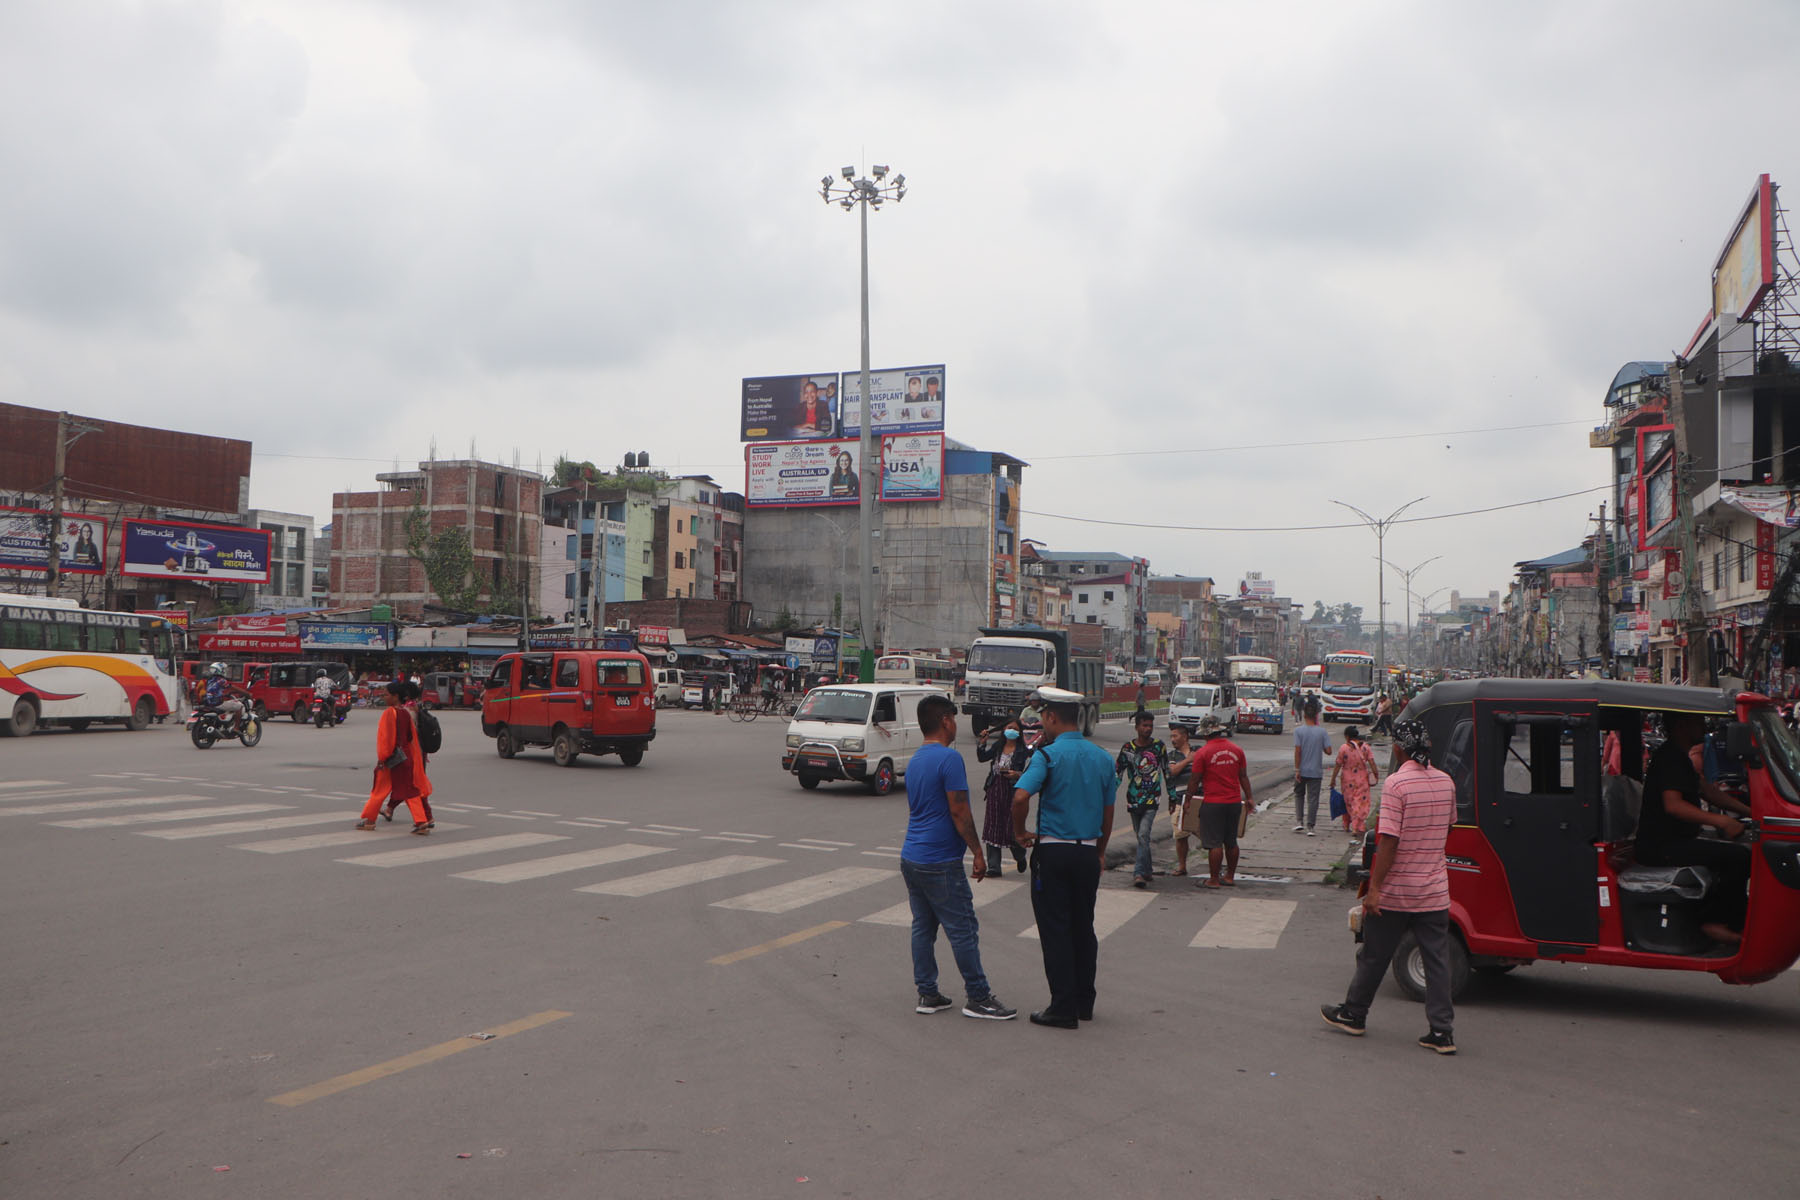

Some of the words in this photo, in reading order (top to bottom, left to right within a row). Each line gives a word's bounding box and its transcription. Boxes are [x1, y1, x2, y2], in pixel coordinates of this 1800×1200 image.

[844, 395, 860, 403] HAIR
[870, 392, 903, 401] ANSPLANT
[890, 461, 920, 473] USA
[136, 527, 174, 537] Yasuda
[1, 539, 50, 549] AUSTRALA
[8, 607, 52, 622] MATA
[56, 611, 84, 624] DEE
[87, 613, 140, 627] DELUXE
[1328, 656, 1371, 665] TOURIST
